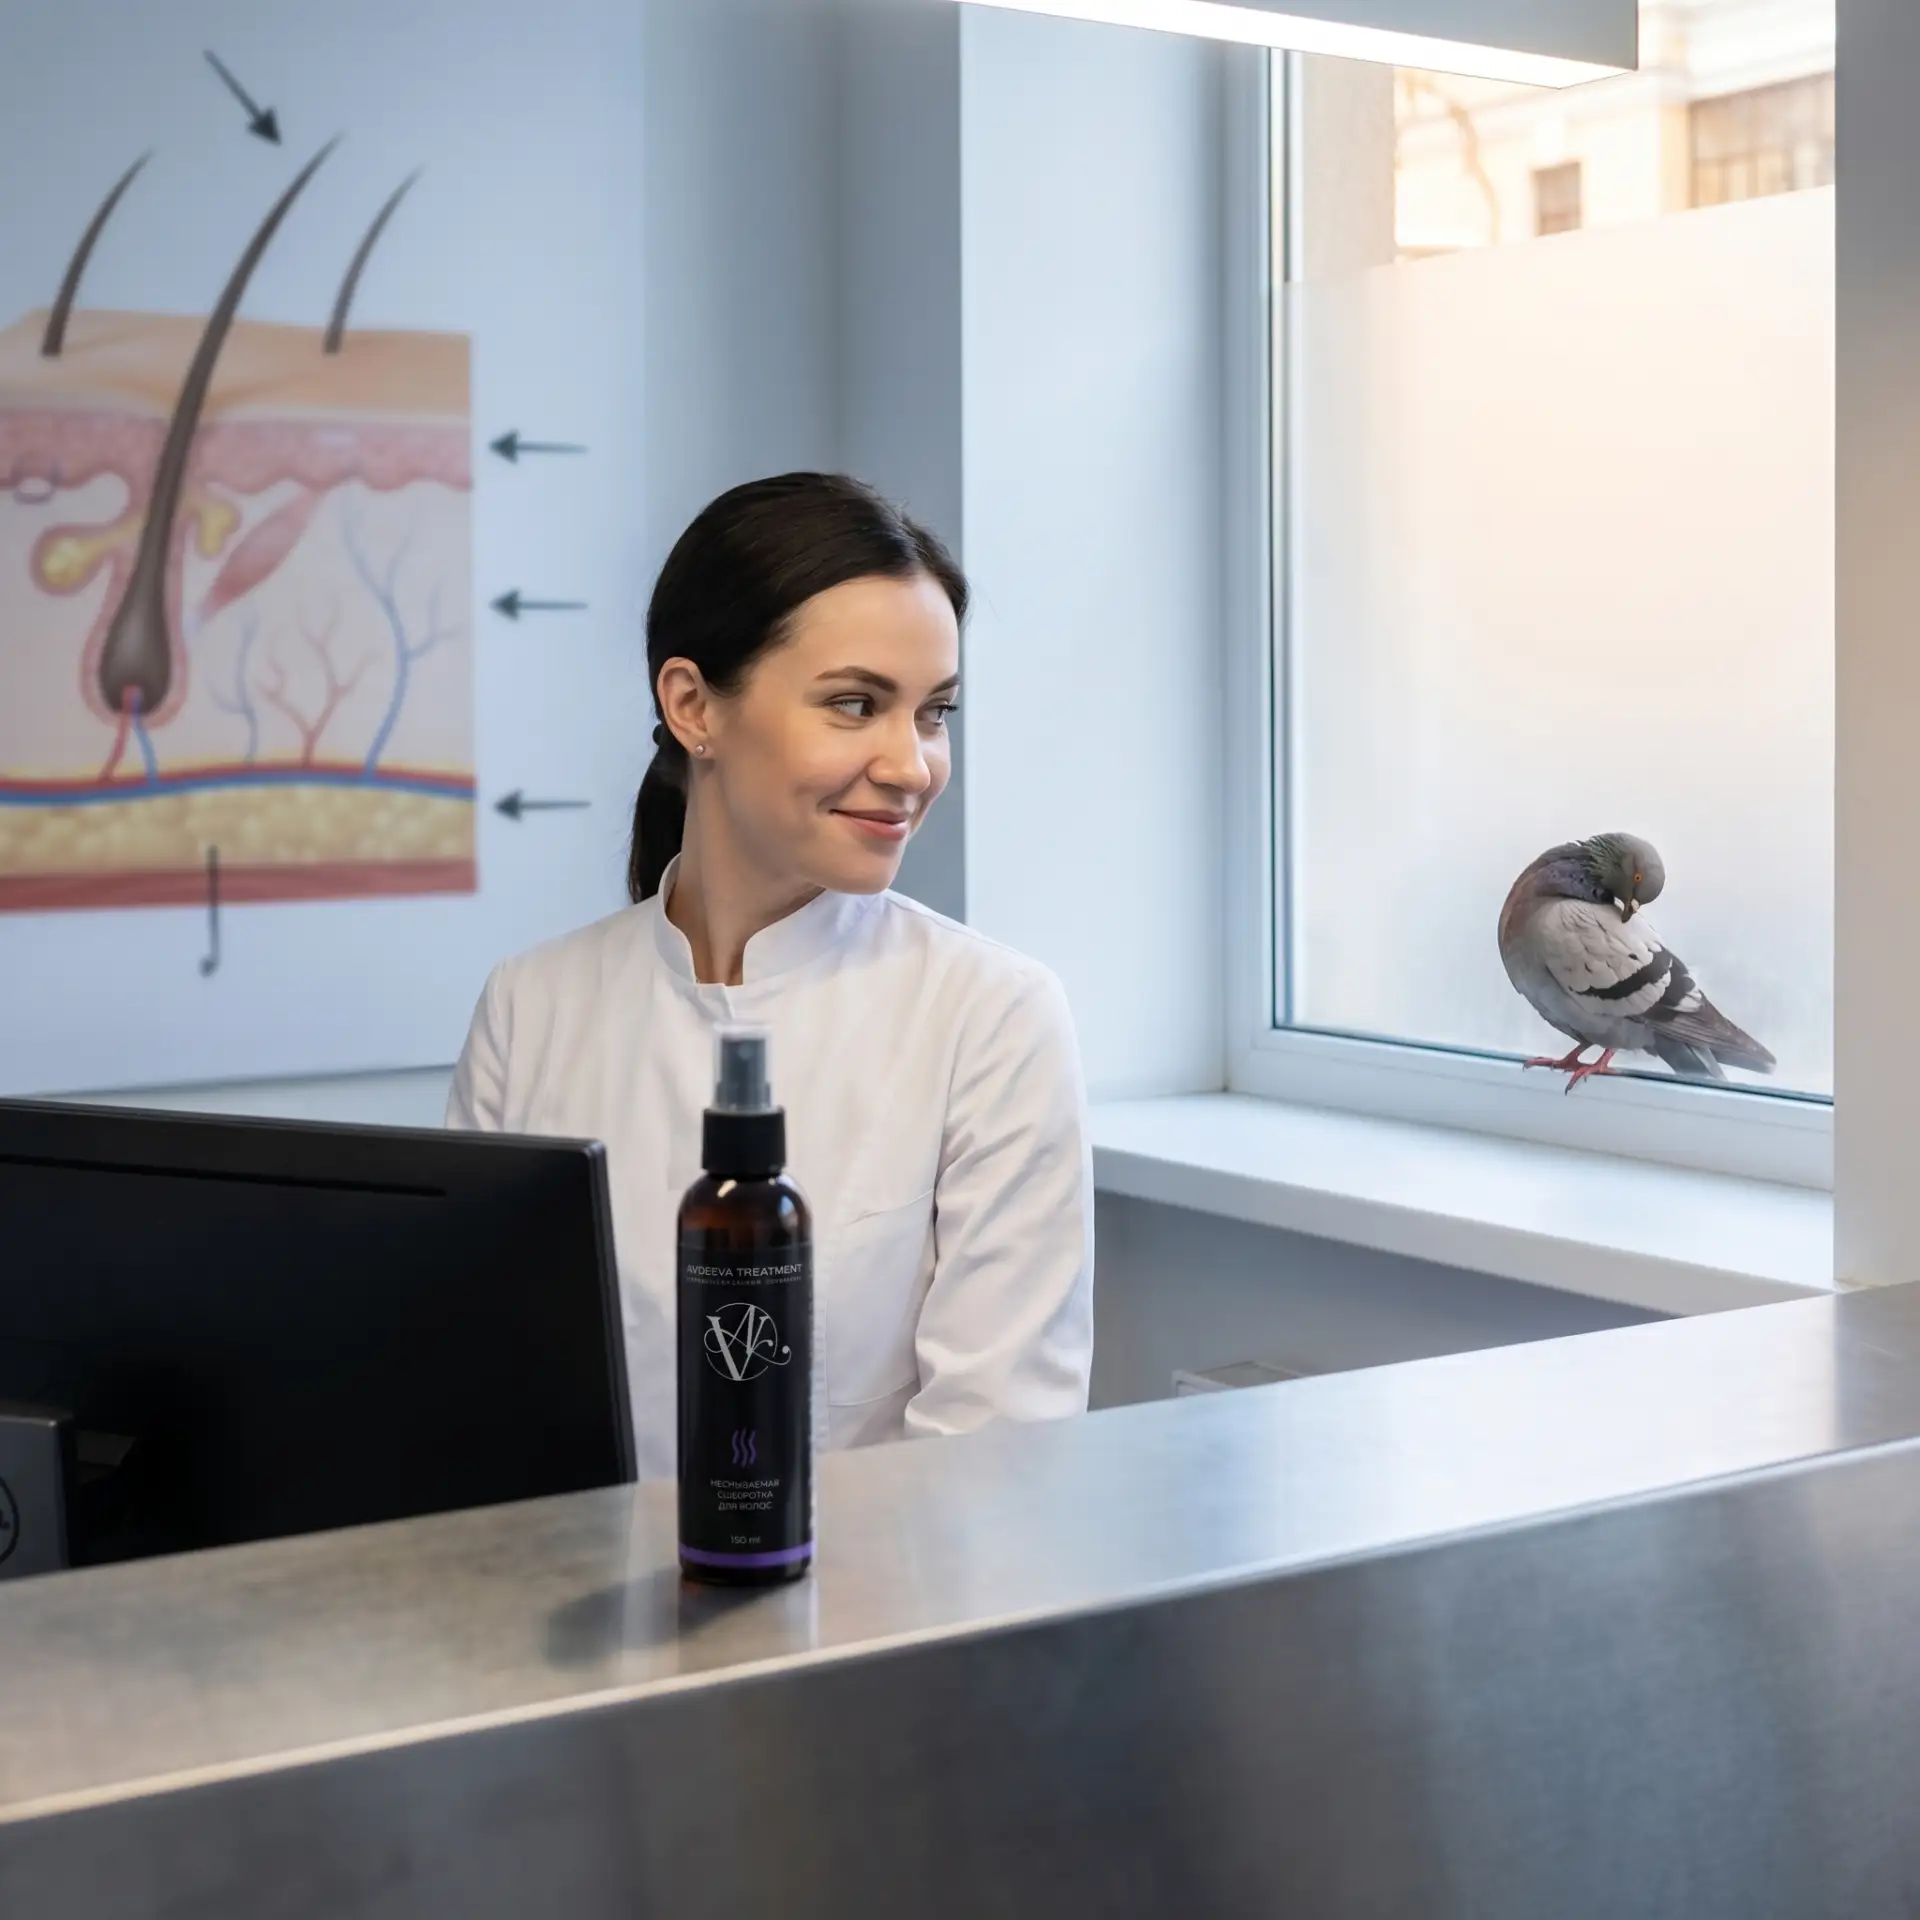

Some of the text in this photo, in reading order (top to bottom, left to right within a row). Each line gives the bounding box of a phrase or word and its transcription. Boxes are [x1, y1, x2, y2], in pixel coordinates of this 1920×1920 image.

[687, 1264, 802, 1276] AVDEEVA TREATMENT
[730, 1534, 747, 1544] 150
